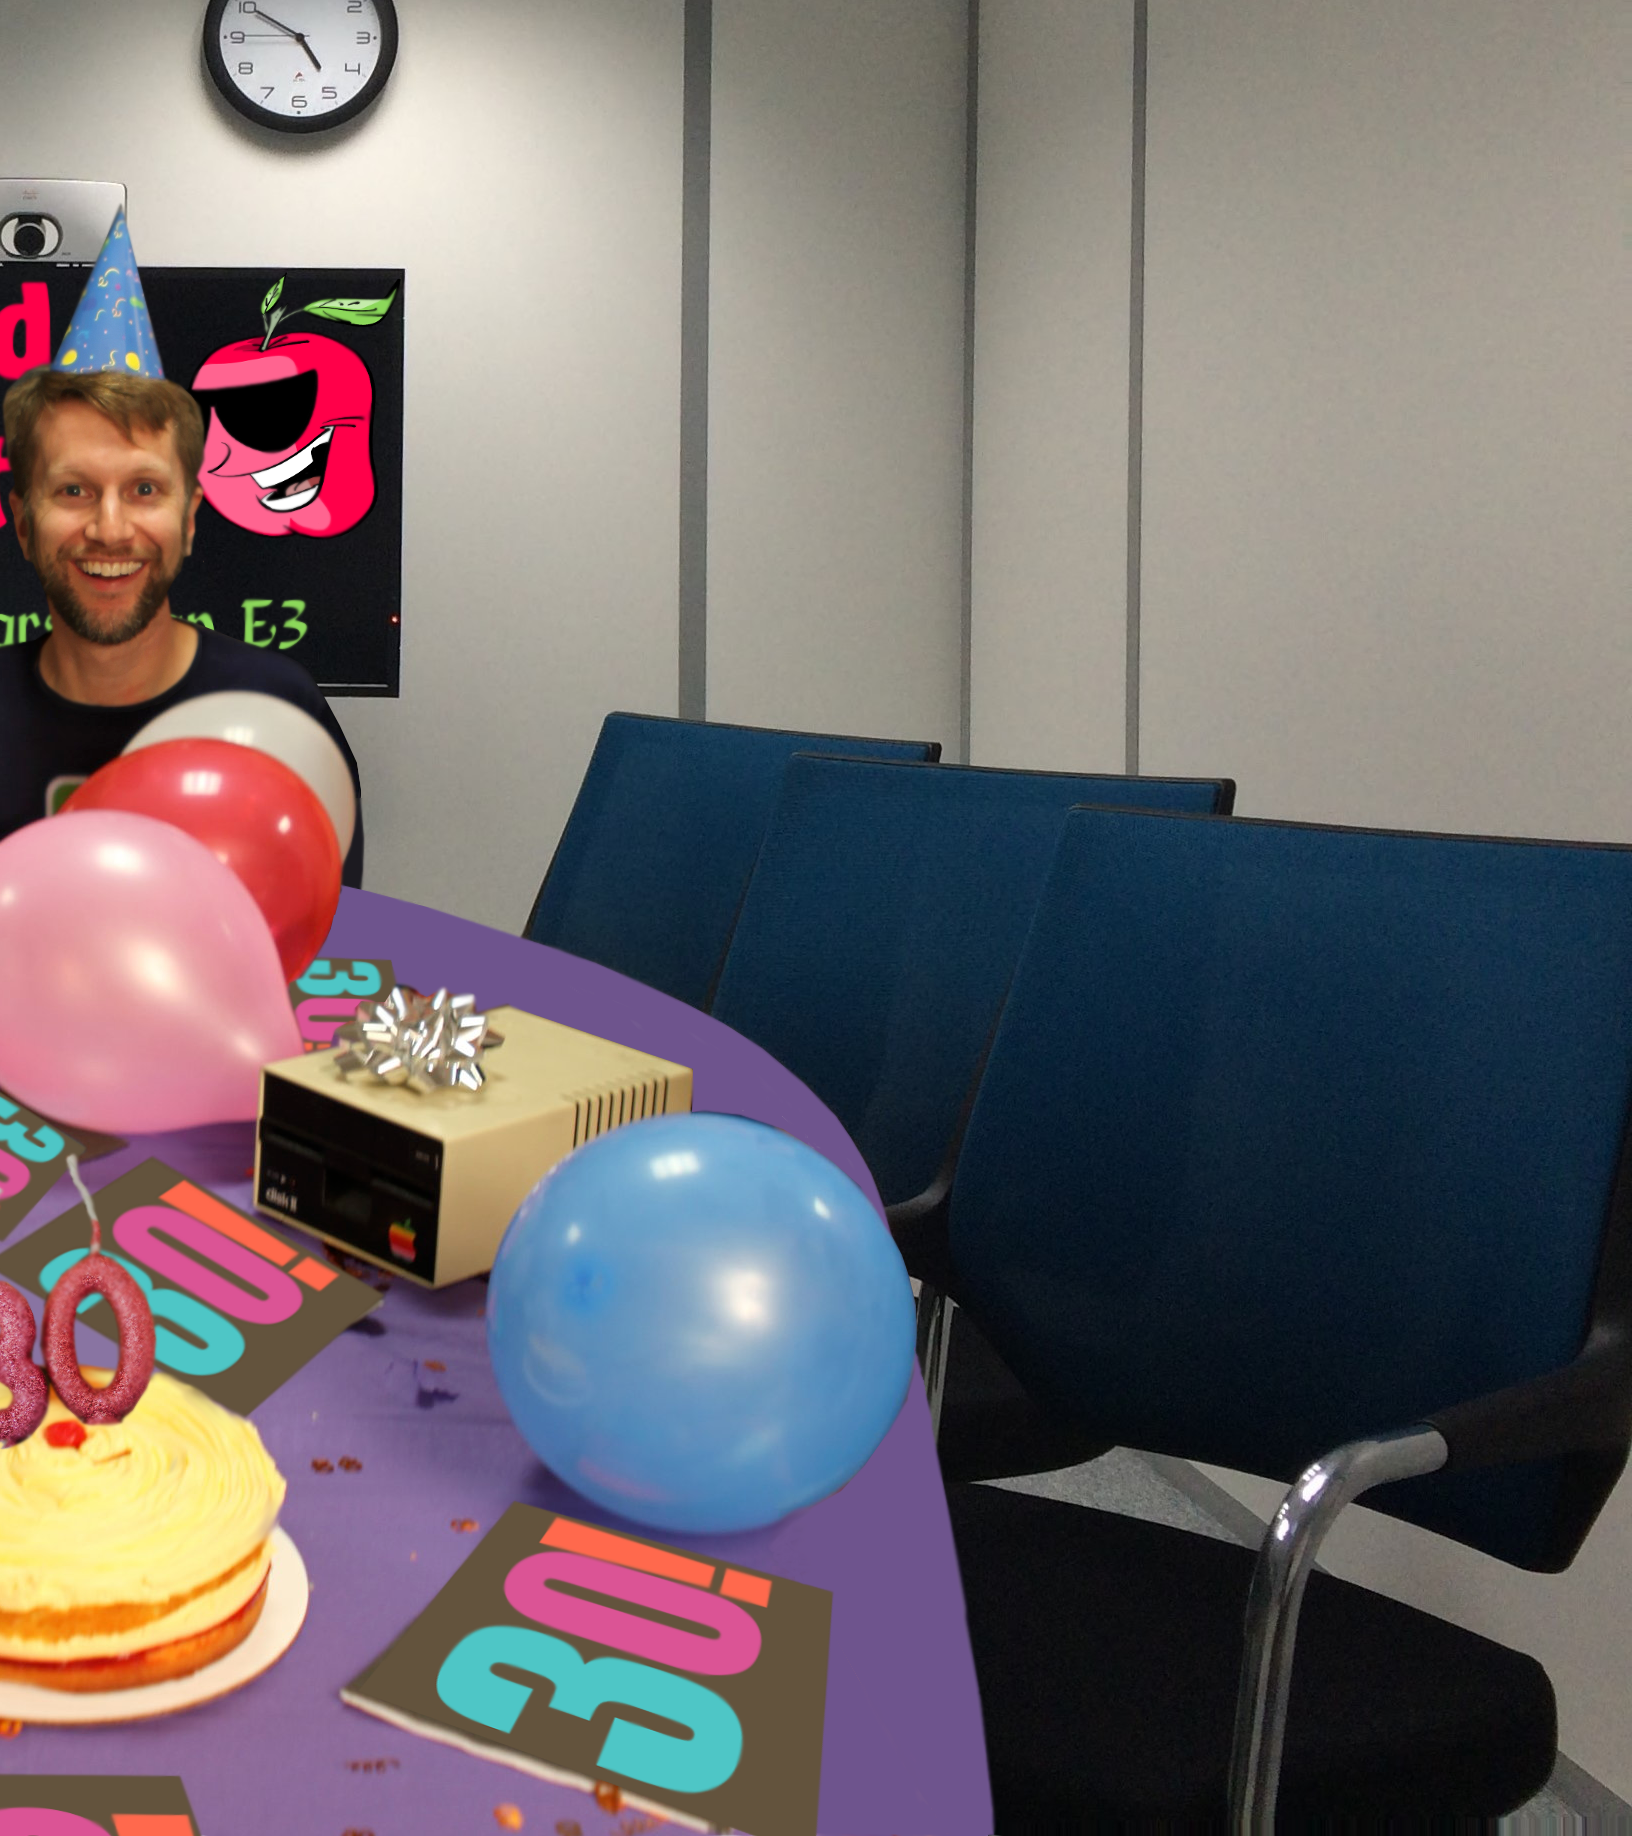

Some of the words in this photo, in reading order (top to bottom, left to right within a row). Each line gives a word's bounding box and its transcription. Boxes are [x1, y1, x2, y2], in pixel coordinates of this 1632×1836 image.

[238, 0, 256, 14] 10
[346, 0, 363, 13] 2
[229, 30, 245, 44] 9
[356, 31, 371, 45] 3
[237, 61, 254, 75] 8
[344, 62, 361, 76] 4
[260, 86, 275, 100] 7
[321, 86, 338, 100] 5
[291, 95, 308, 109] 6
[240, 599, 309, 650] E3
[436, 1516, 773, 1793] 30!
